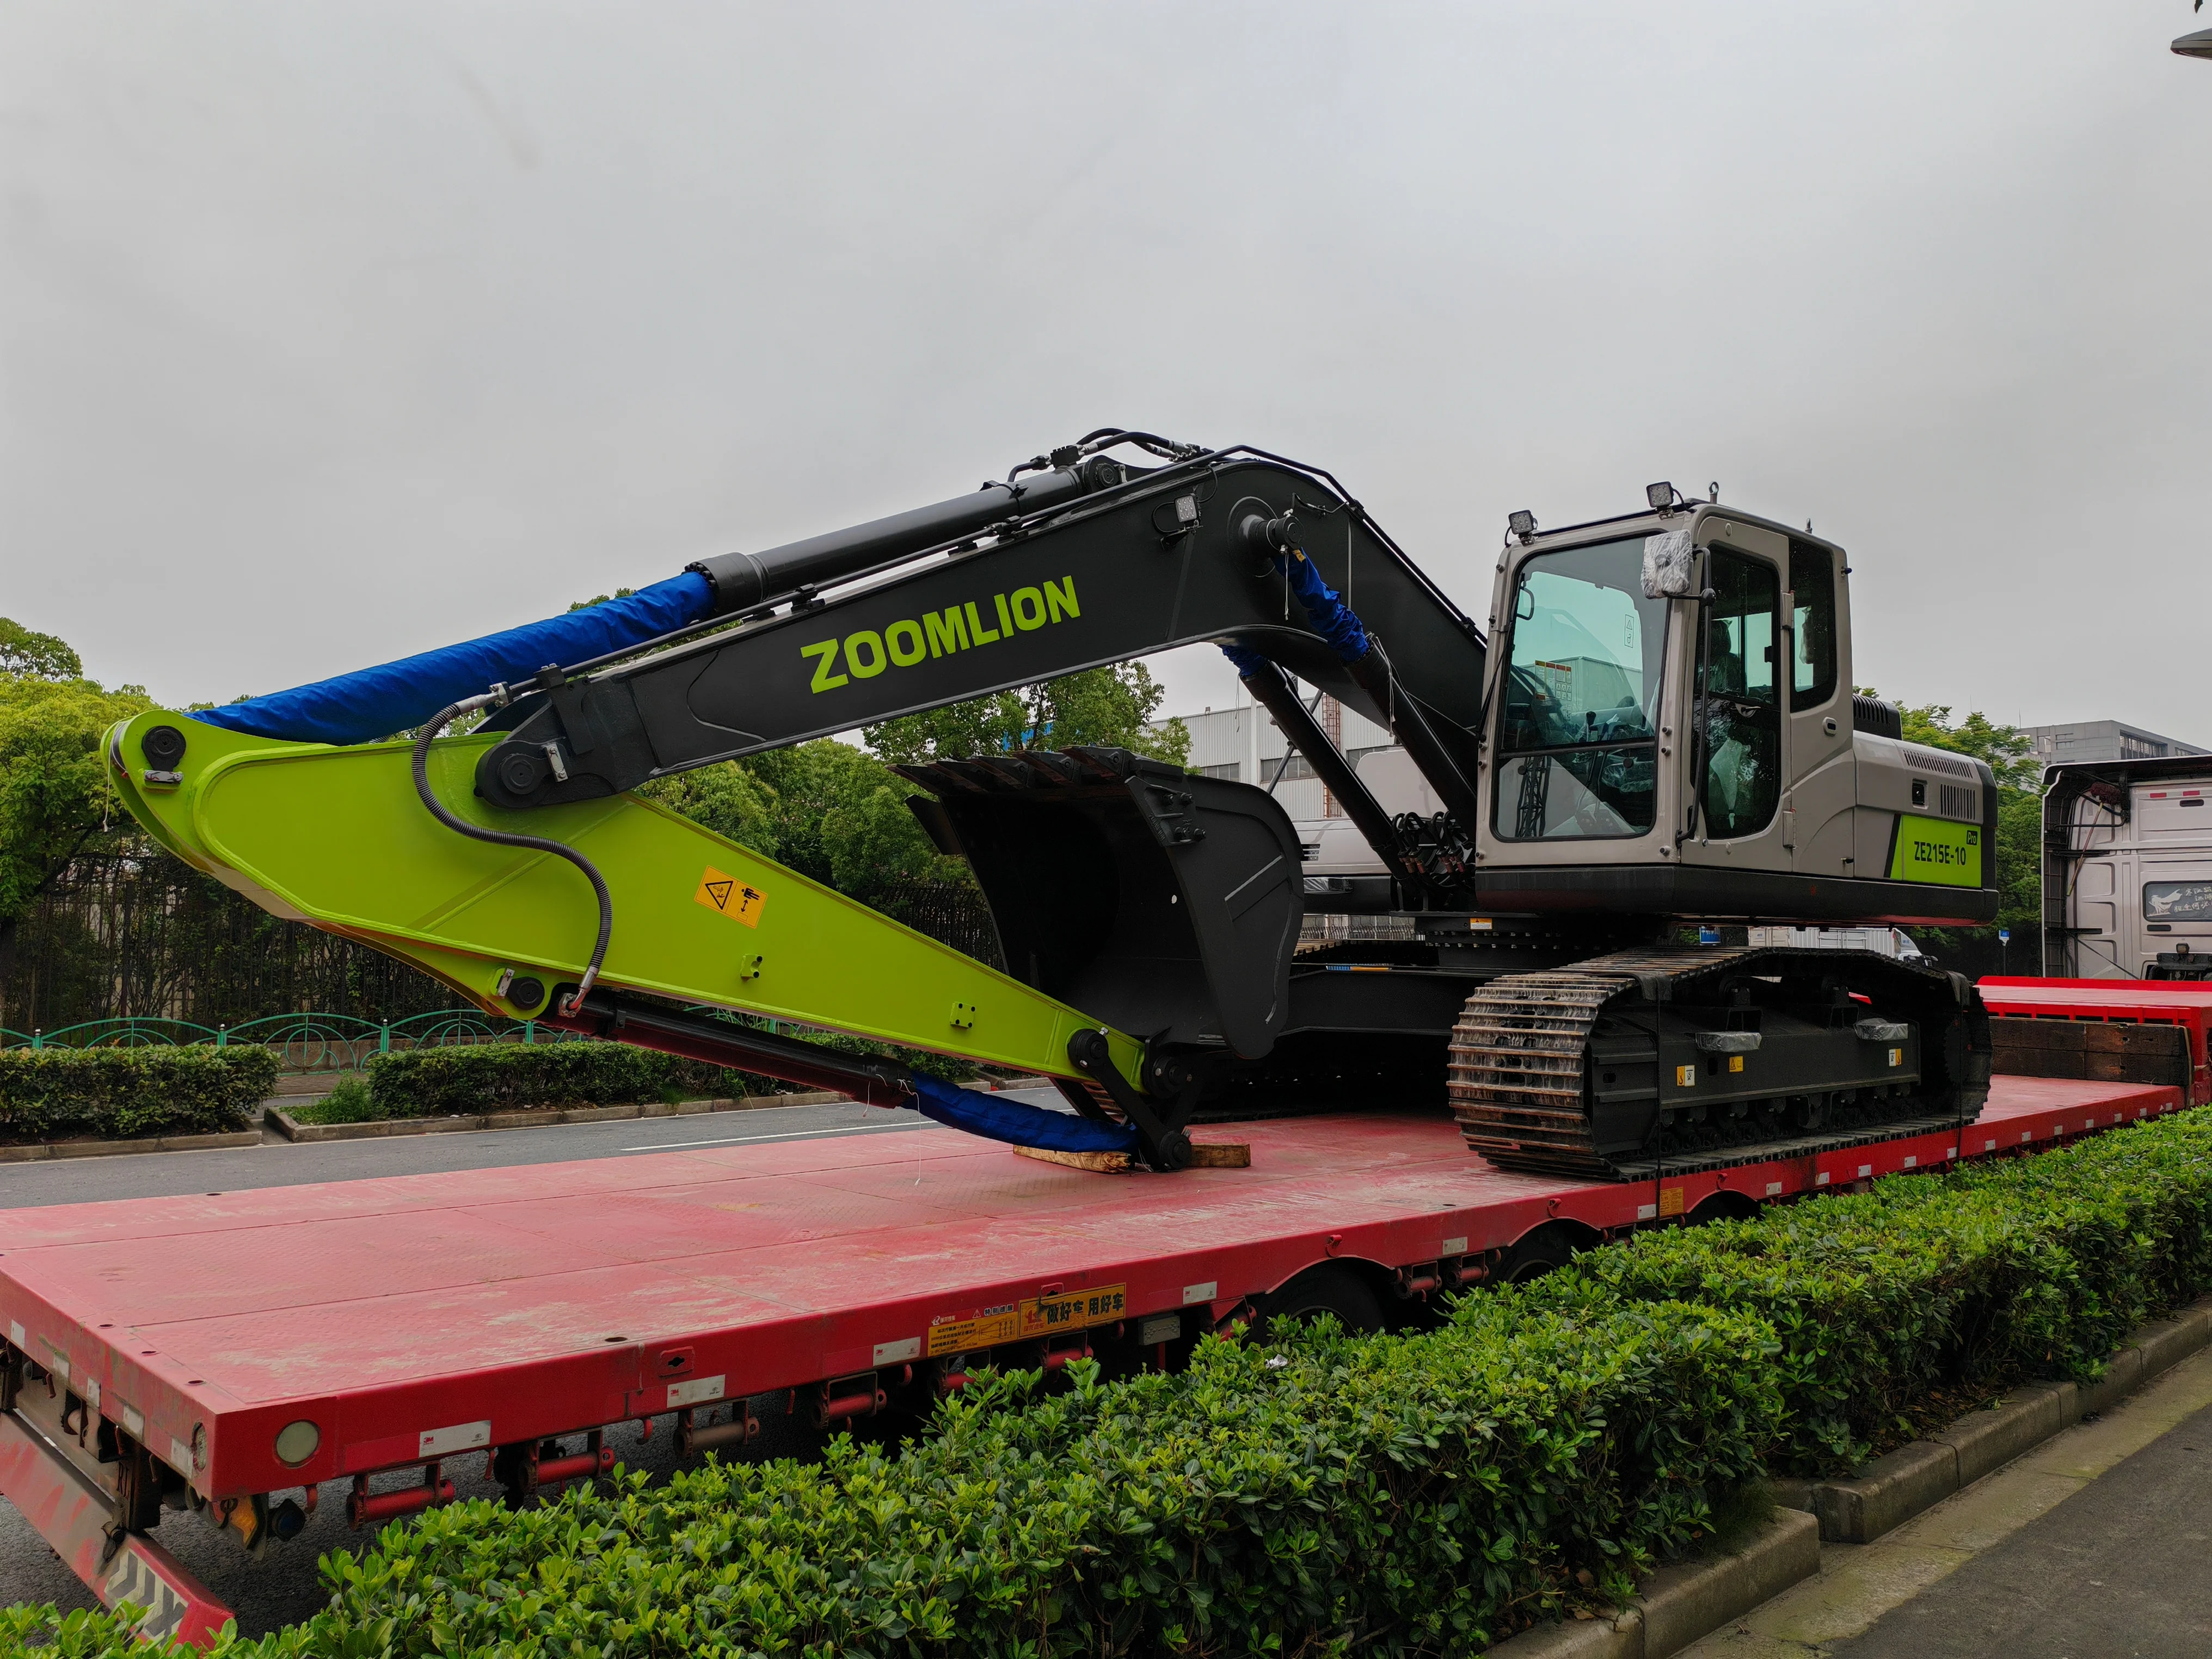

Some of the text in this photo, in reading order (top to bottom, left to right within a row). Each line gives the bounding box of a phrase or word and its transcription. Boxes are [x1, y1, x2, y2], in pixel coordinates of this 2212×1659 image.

[800, 575, 1080, 693] ZOOMLION
[1967, 832, 1977, 844] Pro
[1914, 841, 1966, 866] ZE215E-10
[984, 1304, 1014, 1317] 特别提醒
[1087, 1292, 1123, 1317] 用好车
